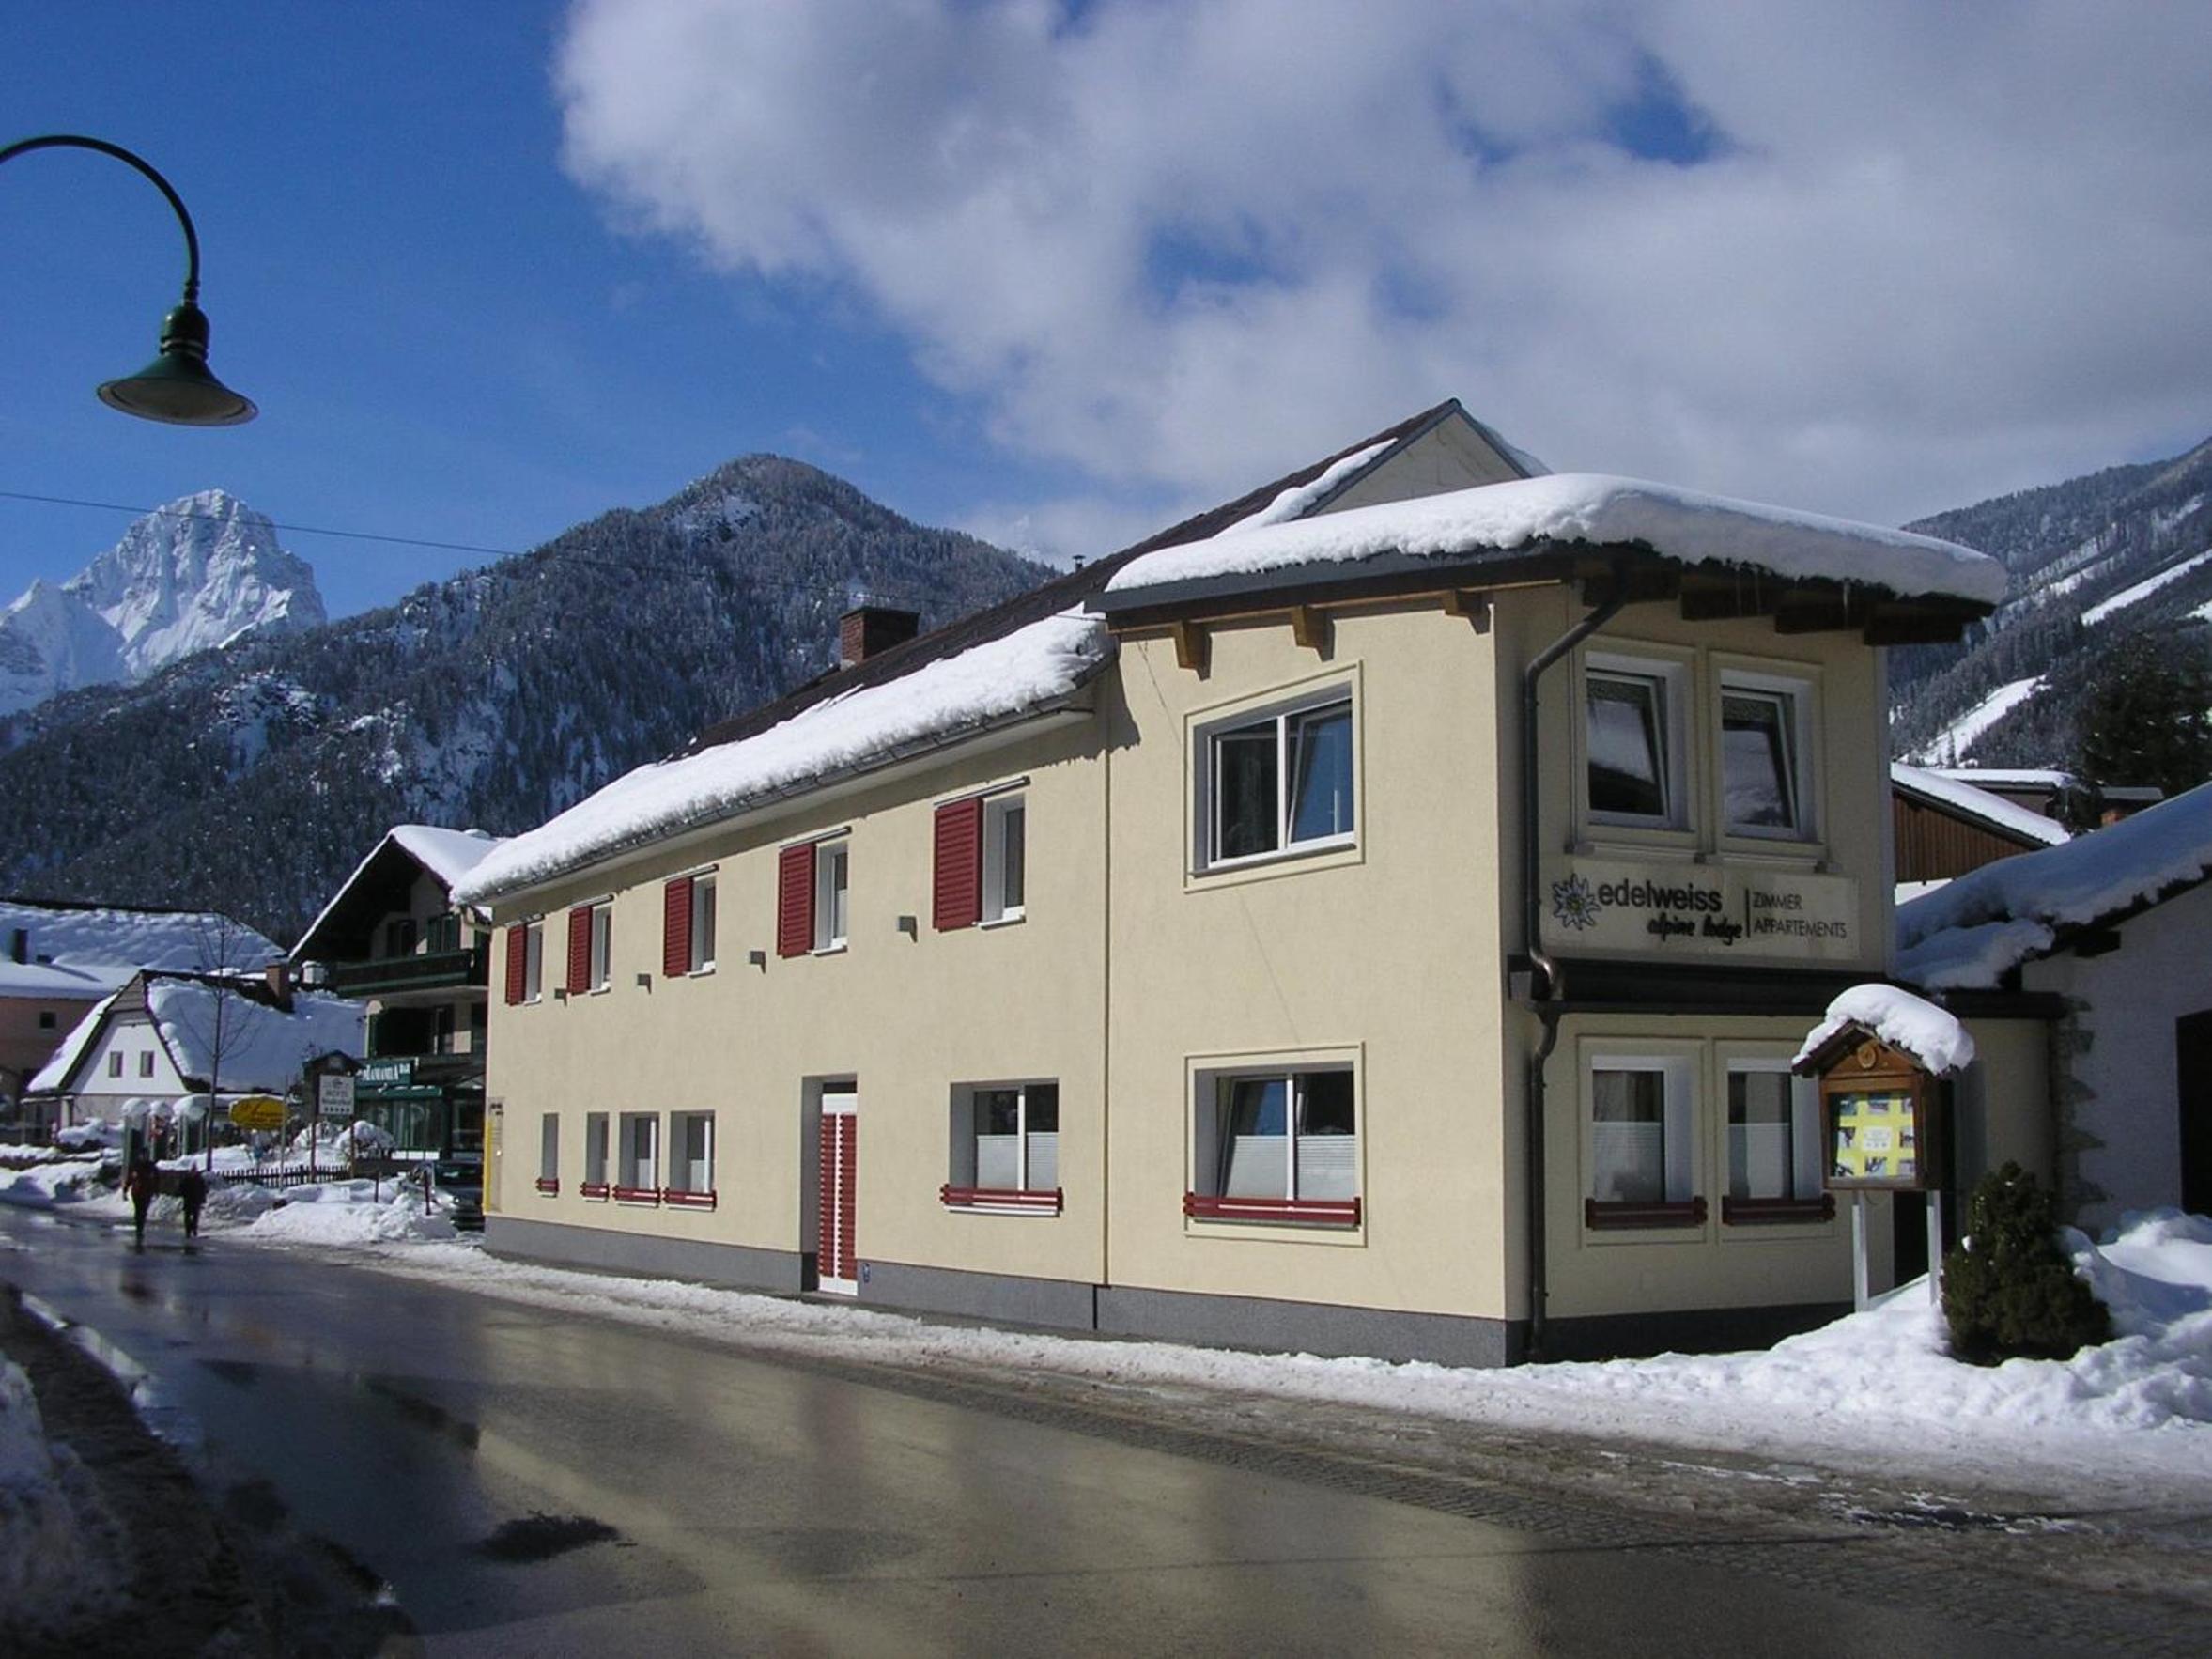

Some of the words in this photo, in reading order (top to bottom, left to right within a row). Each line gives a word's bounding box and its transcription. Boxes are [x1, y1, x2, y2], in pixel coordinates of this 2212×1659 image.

[1598, 877, 1723, 912] edelweiss
[1752, 892, 1803, 910] ZIMMER
[1647, 912, 1695, 942] alpine
[1702, 914, 1743, 946] lodge
[1754, 917, 1847, 938] APPARTEMENTS
